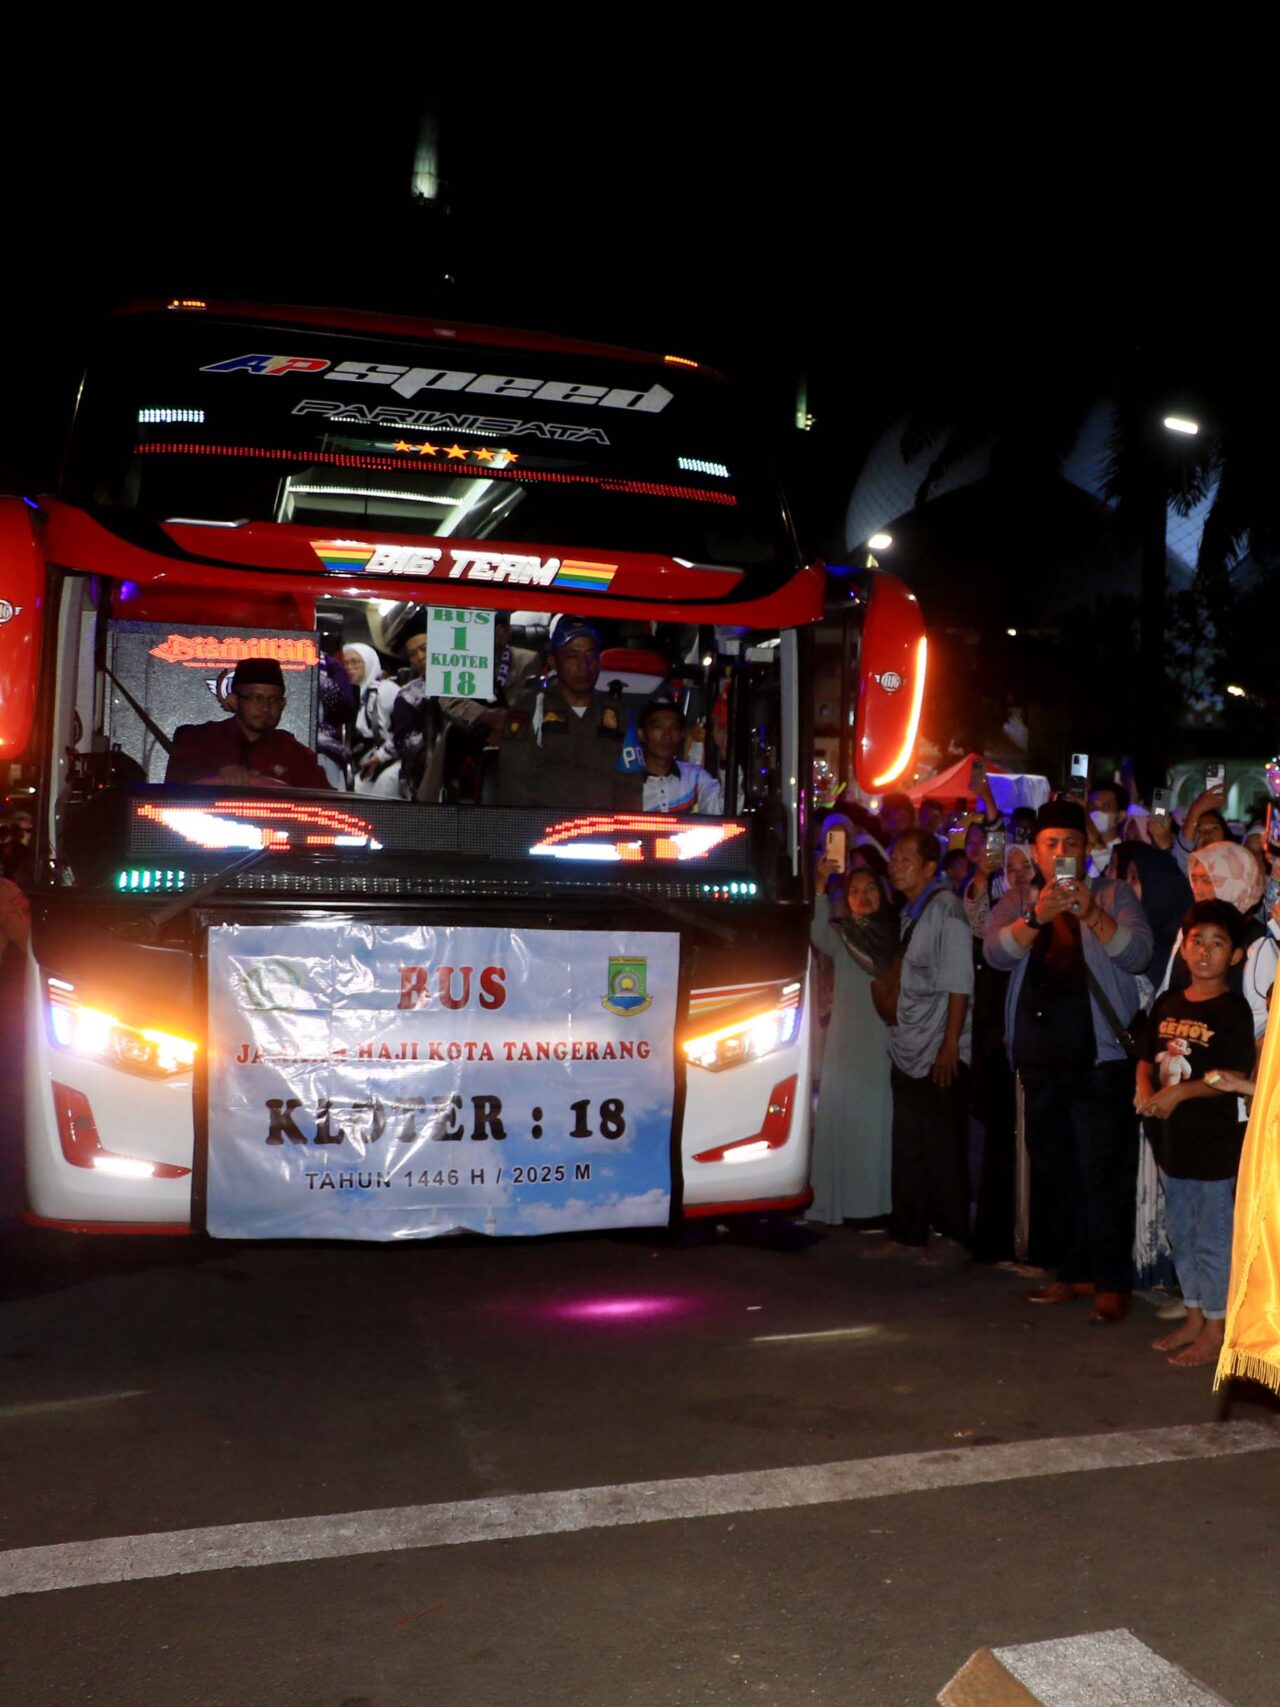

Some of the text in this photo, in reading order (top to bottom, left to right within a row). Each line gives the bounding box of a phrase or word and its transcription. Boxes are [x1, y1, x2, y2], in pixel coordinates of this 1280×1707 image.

[324, 361, 674, 413] speed
[291, 400, 611, 445] PARIWISATA
[365, 544, 561, 585] BIG TEAM
[434, 608, 490, 624] BUS
[450, 626, 469, 651] 1
[431, 653, 489, 669] KLOTER
[441, 671, 476, 696] 18
[398, 966, 507, 1010] BUS
[358, 1042, 419, 1061] HAJI
[428, 1041, 495, 1061] KOTA
[503, 1040, 650, 1060] TANGERANG
[265, 1094, 507, 1145] KLOTER
[569, 1098, 626, 1140] 18
[305, 1171, 392, 1190] TAHUN
[404, 1169, 459, 1187] 1446
[470, 1168, 485, 1185] H
[513, 1165, 565, 1184] 2025
[575, 1164, 591, 1181] M
